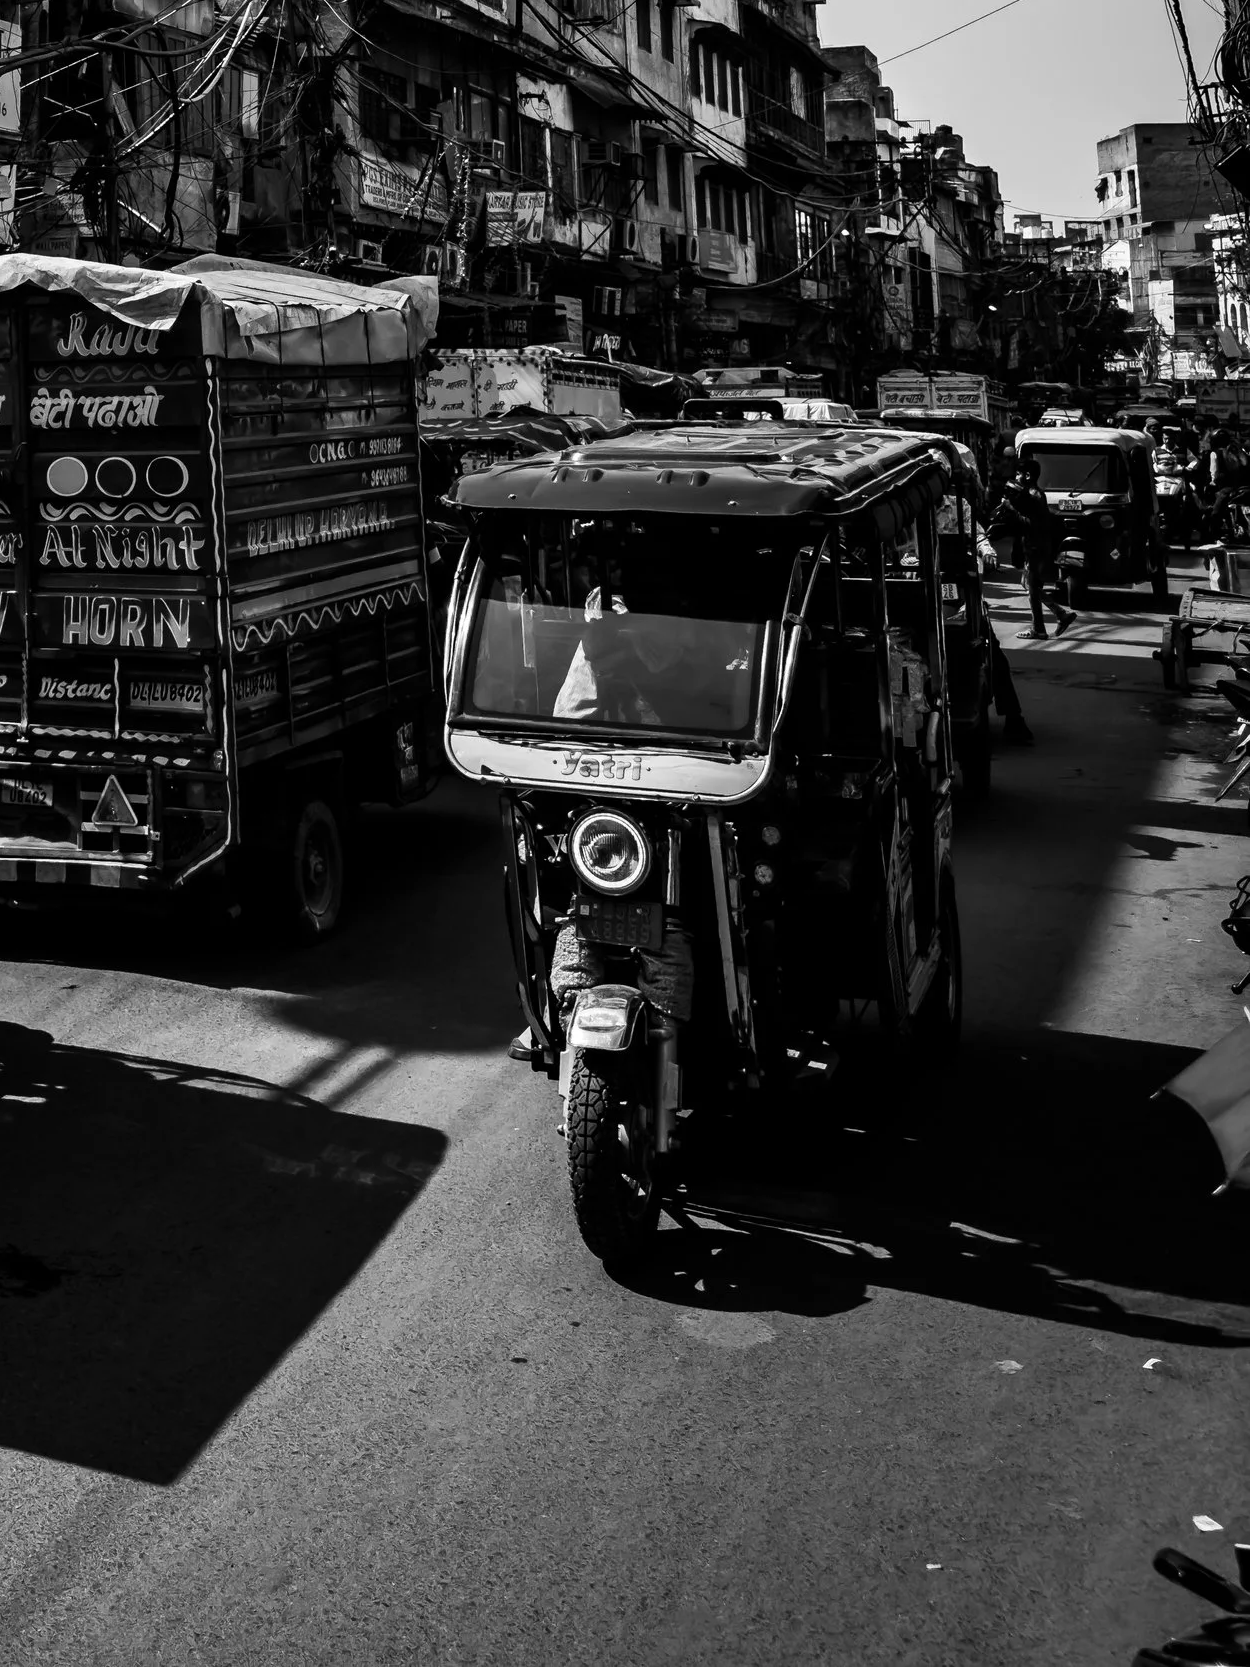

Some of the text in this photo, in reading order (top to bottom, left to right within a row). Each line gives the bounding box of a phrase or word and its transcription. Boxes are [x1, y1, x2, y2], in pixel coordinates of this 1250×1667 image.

[29, 387, 77, 429] बेटी
[39, 524, 206, 571] At Night
[62, 594, 191, 649] HORN
[560, 750, 643, 781] Yatri
